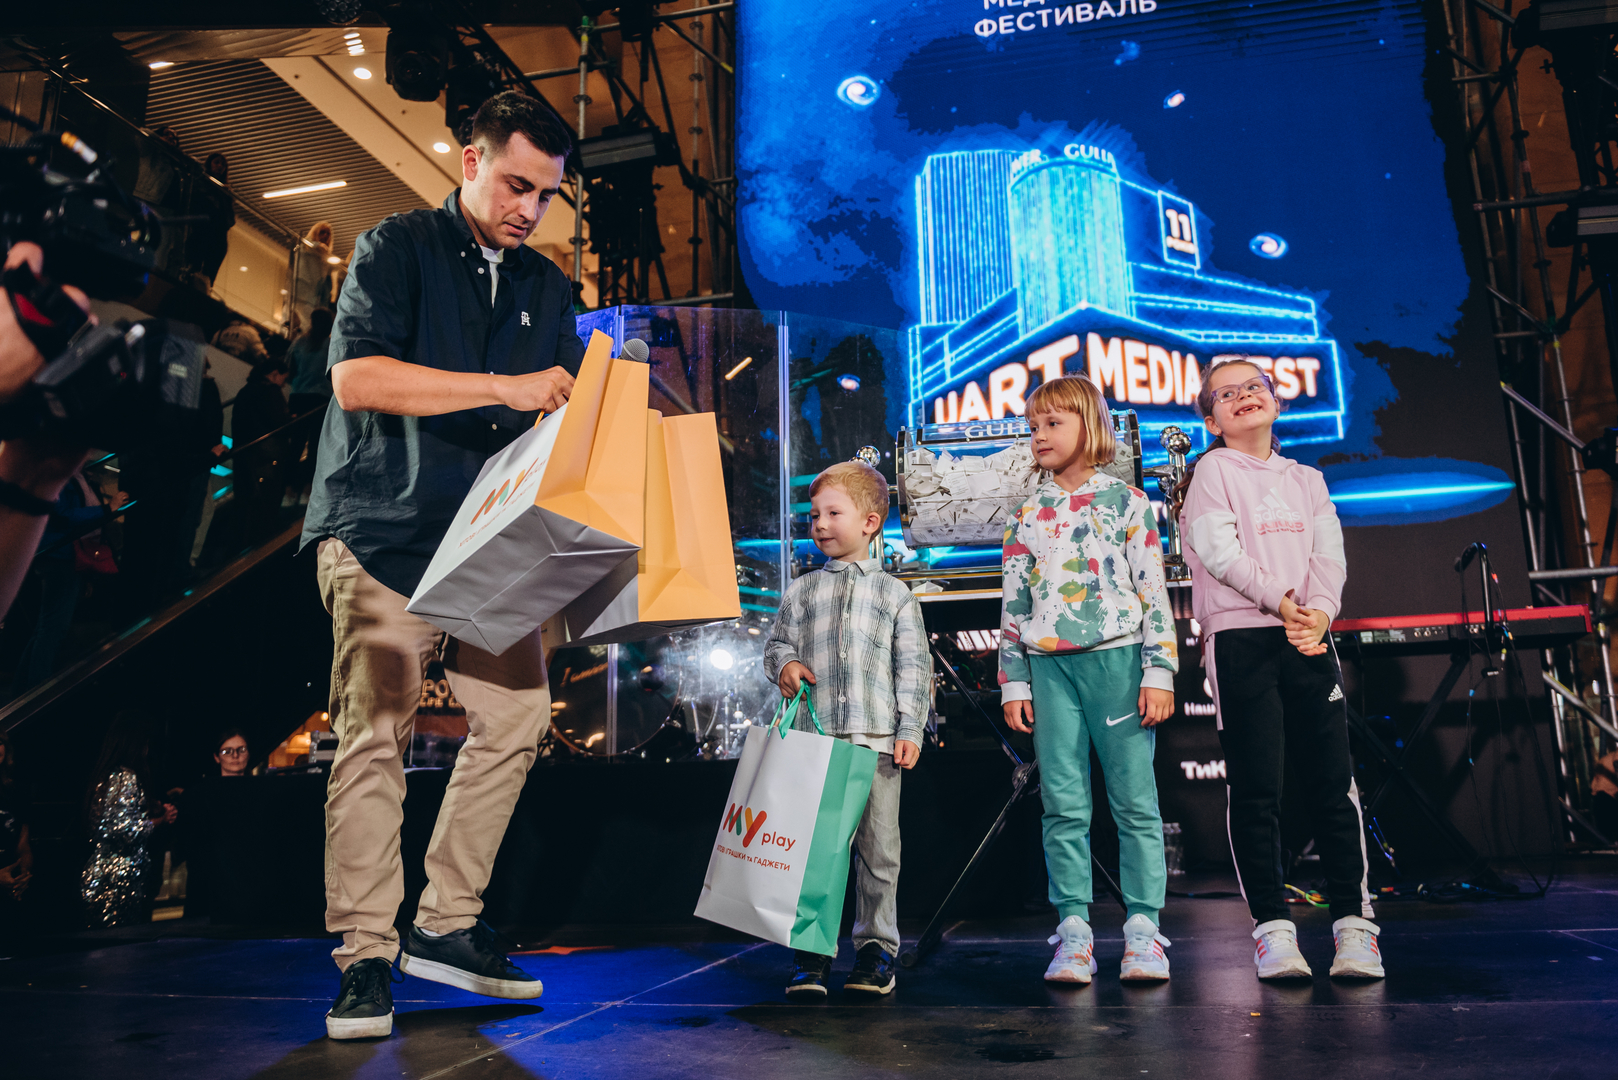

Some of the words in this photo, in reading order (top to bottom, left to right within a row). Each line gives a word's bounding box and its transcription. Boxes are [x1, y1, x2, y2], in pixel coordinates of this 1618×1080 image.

[974, 0, 1157, 37] ФЕСТИВАЛЬ
[1165, 209, 1191, 242] 11
[934, 334, 1080, 424] UART
[1086, 332, 1203, 405] MEDIA
[1211, 353, 1321, 401] ST
[1253, 508, 1301, 523] adidas
[723, 802, 767, 848] MY
[761, 831, 796, 852] play
[753, 856, 791, 871] ГАДЖЕТИ
